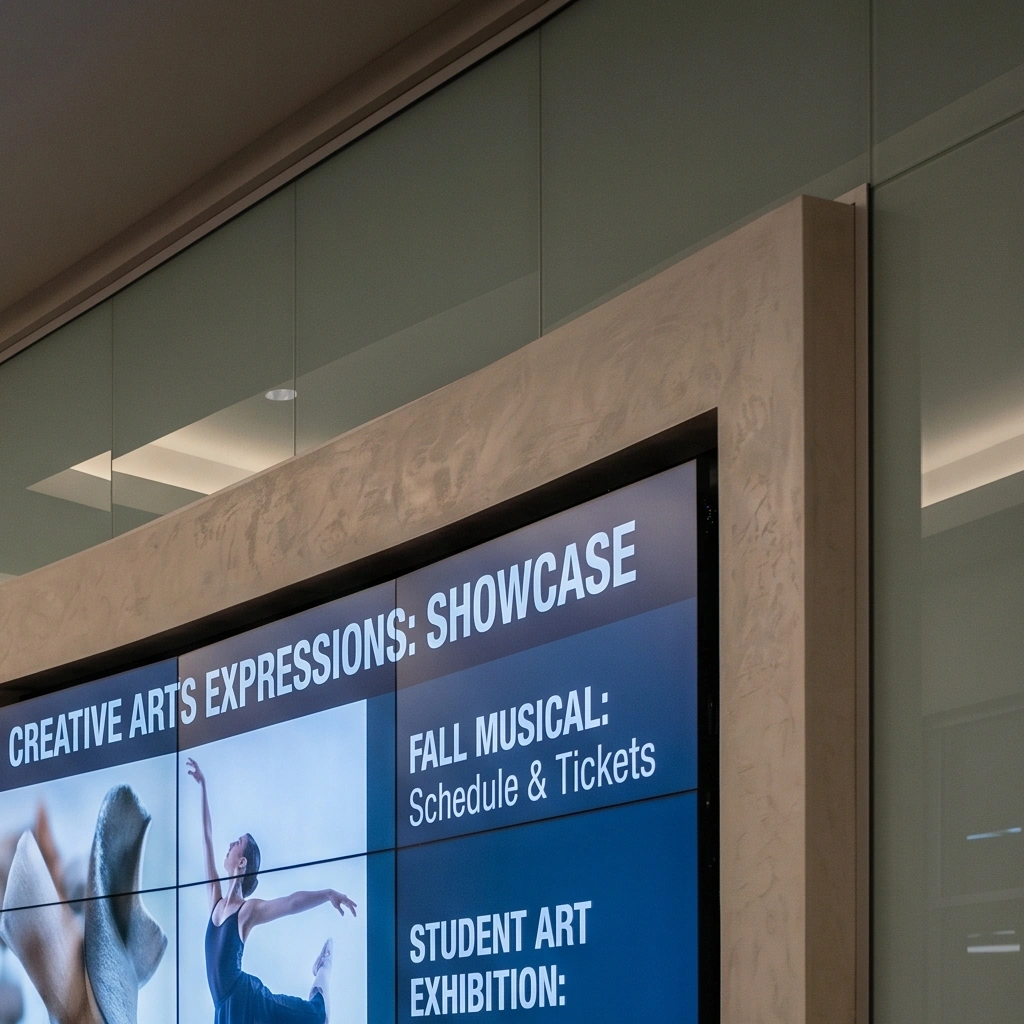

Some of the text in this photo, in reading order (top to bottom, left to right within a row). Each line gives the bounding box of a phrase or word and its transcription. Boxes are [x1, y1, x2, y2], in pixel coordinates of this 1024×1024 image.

[9, 520, 637, 767] CREATIVE ARTS EXPRESSIONS: SHOWCASE
[409, 685, 609, 774] FALL MUSICAL:
[409, 737, 656, 827] Schedule & Tickets
[410, 901, 592, 963] STUDENT ART
[410, 965, 565, 1017] EXHIBITION:
